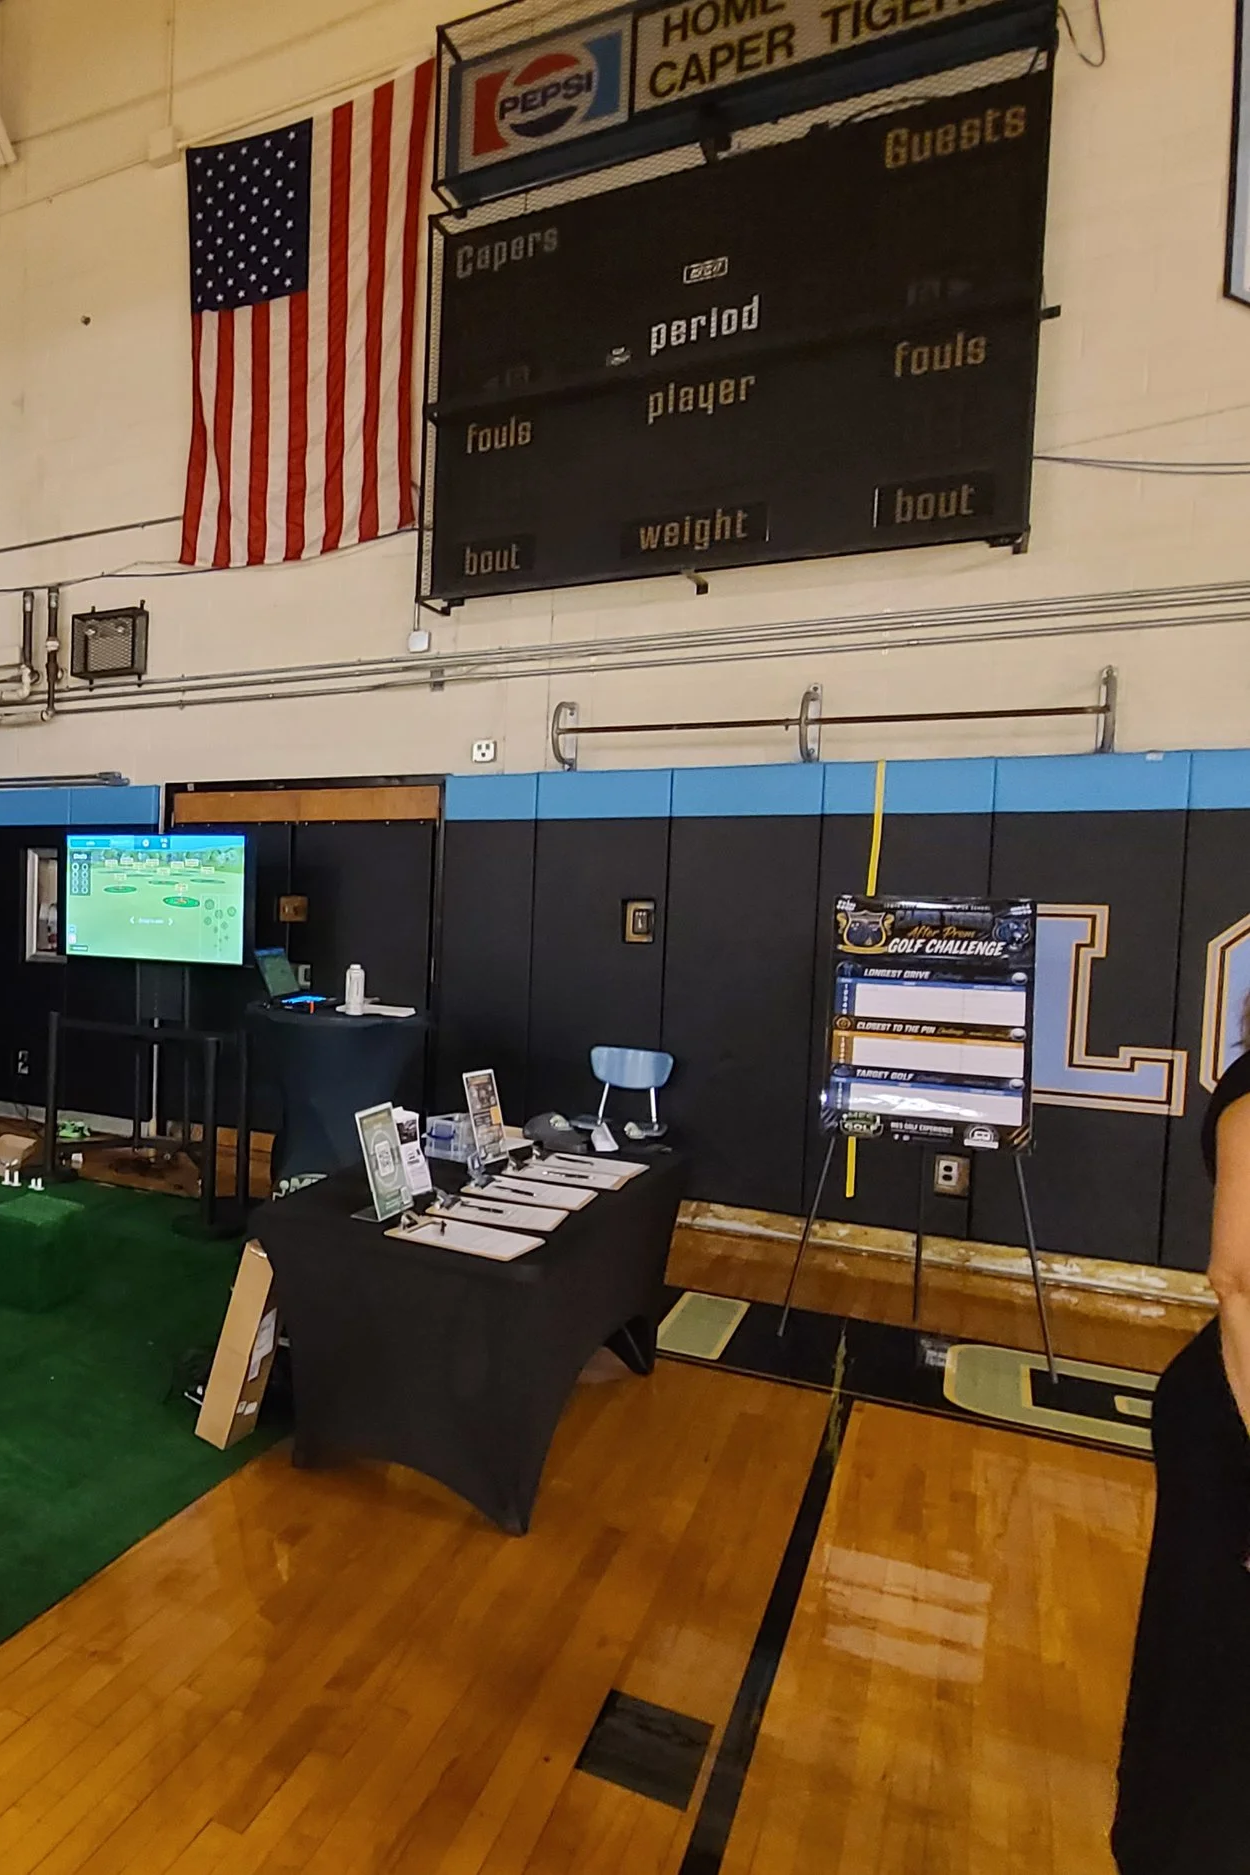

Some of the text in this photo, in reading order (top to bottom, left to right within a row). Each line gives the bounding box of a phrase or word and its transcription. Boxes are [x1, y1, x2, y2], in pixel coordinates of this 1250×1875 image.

[649, 0, 967, 98] CAPER TIGE
[499, 70, 594, 121] PEPSI
[884, 105, 1026, 168] Guests
[456, 227, 558, 279] Capers
[650, 294, 759, 356] period
[893, 332, 987, 378] fouls
[648, 372, 755, 424] player
[466, 417, 533, 454] fouls
[894, 484, 974, 524] bout
[638, 508, 748, 551] weight
[463, 543, 521, 577] bout
[887, 937, 1007, 956] GOLF CHALLENGE
[908, 925, 940, 938] After
[863, 968, 902, 978] LONGEST
[903, 969, 931, 979] DRIVE
[856, 1021, 891, 1031] CLOSEST
[892, 1023, 903, 1032] TO
[904, 1024, 920, 1033] THE
[920, 1025, 937, 1035] PIN
[855, 1069, 889, 1079] TARGET
[890, 1072, 915, 1081] GOLF
